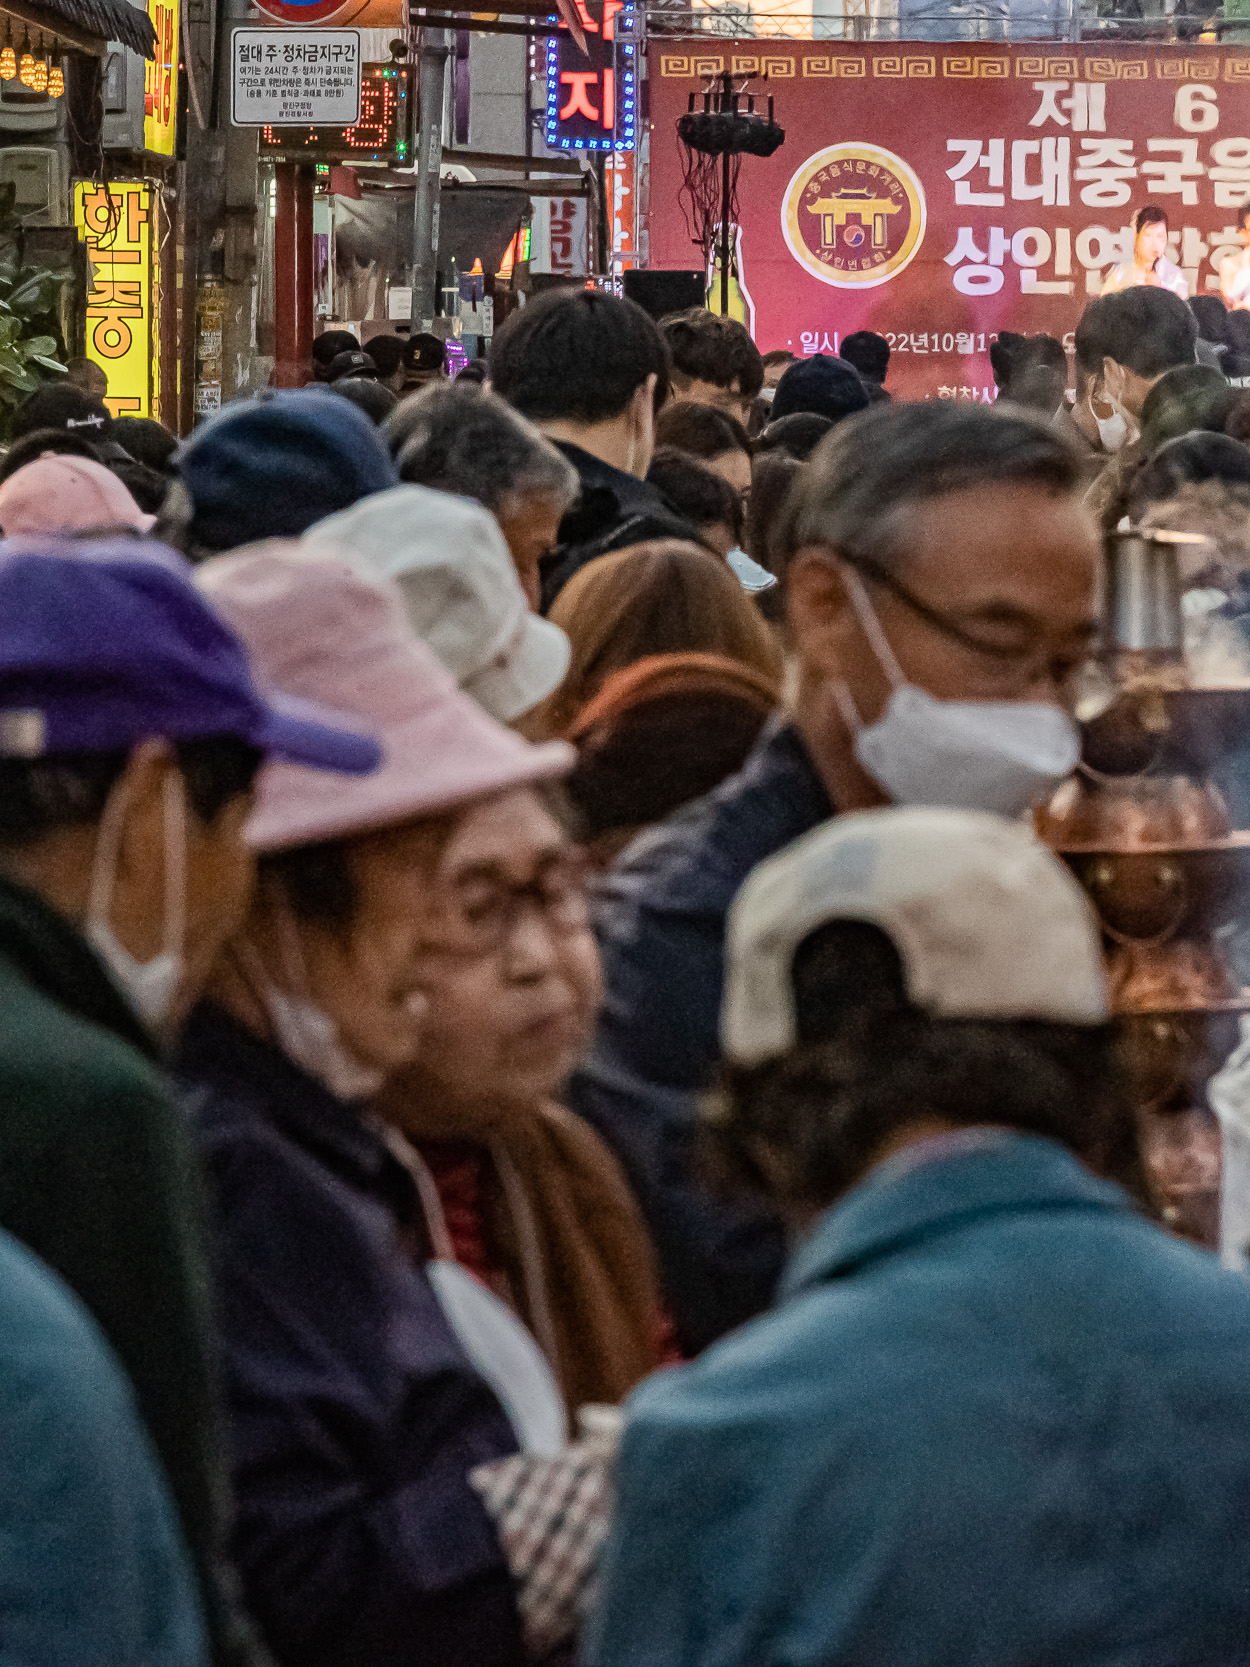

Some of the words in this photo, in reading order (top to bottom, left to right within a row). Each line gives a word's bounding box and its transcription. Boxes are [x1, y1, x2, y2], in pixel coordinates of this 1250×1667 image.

[239, 44, 262, 62] 절대
[265, 44, 356, 62] 주·정차금지구간
[239, 66, 261, 75] 여기는
[264, 66, 289, 75] 24시간
[325, 66, 354, 75] 금지되는
[1028, 80, 1106, 131] 제
[1175, 83, 1219, 132] 6
[800, 331, 839, 354] 일시
[877, 332, 999, 354] 22년10월1
